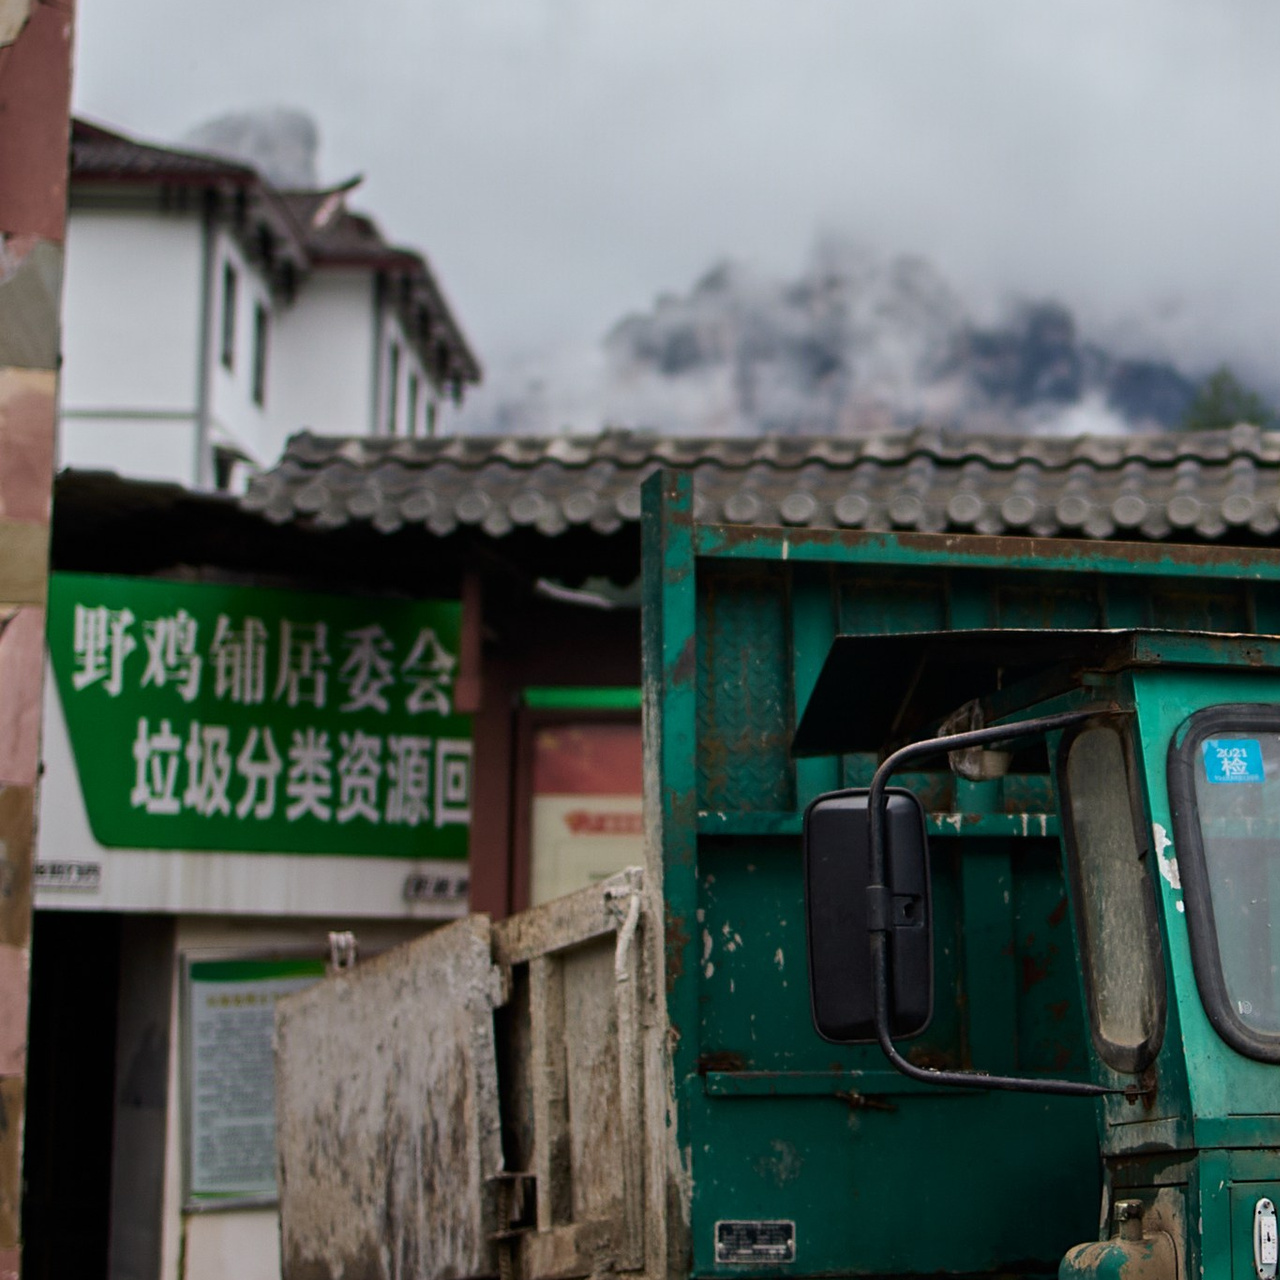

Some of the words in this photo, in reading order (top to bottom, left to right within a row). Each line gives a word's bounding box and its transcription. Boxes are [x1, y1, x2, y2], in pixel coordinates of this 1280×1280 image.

[72, 603, 456, 717] 野鸡铺居委会
[130, 717, 473, 827] 垃圾分类资源回
[1216, 747, 1248, 758] 2021
[1220, 757, 1249, 777] 检
